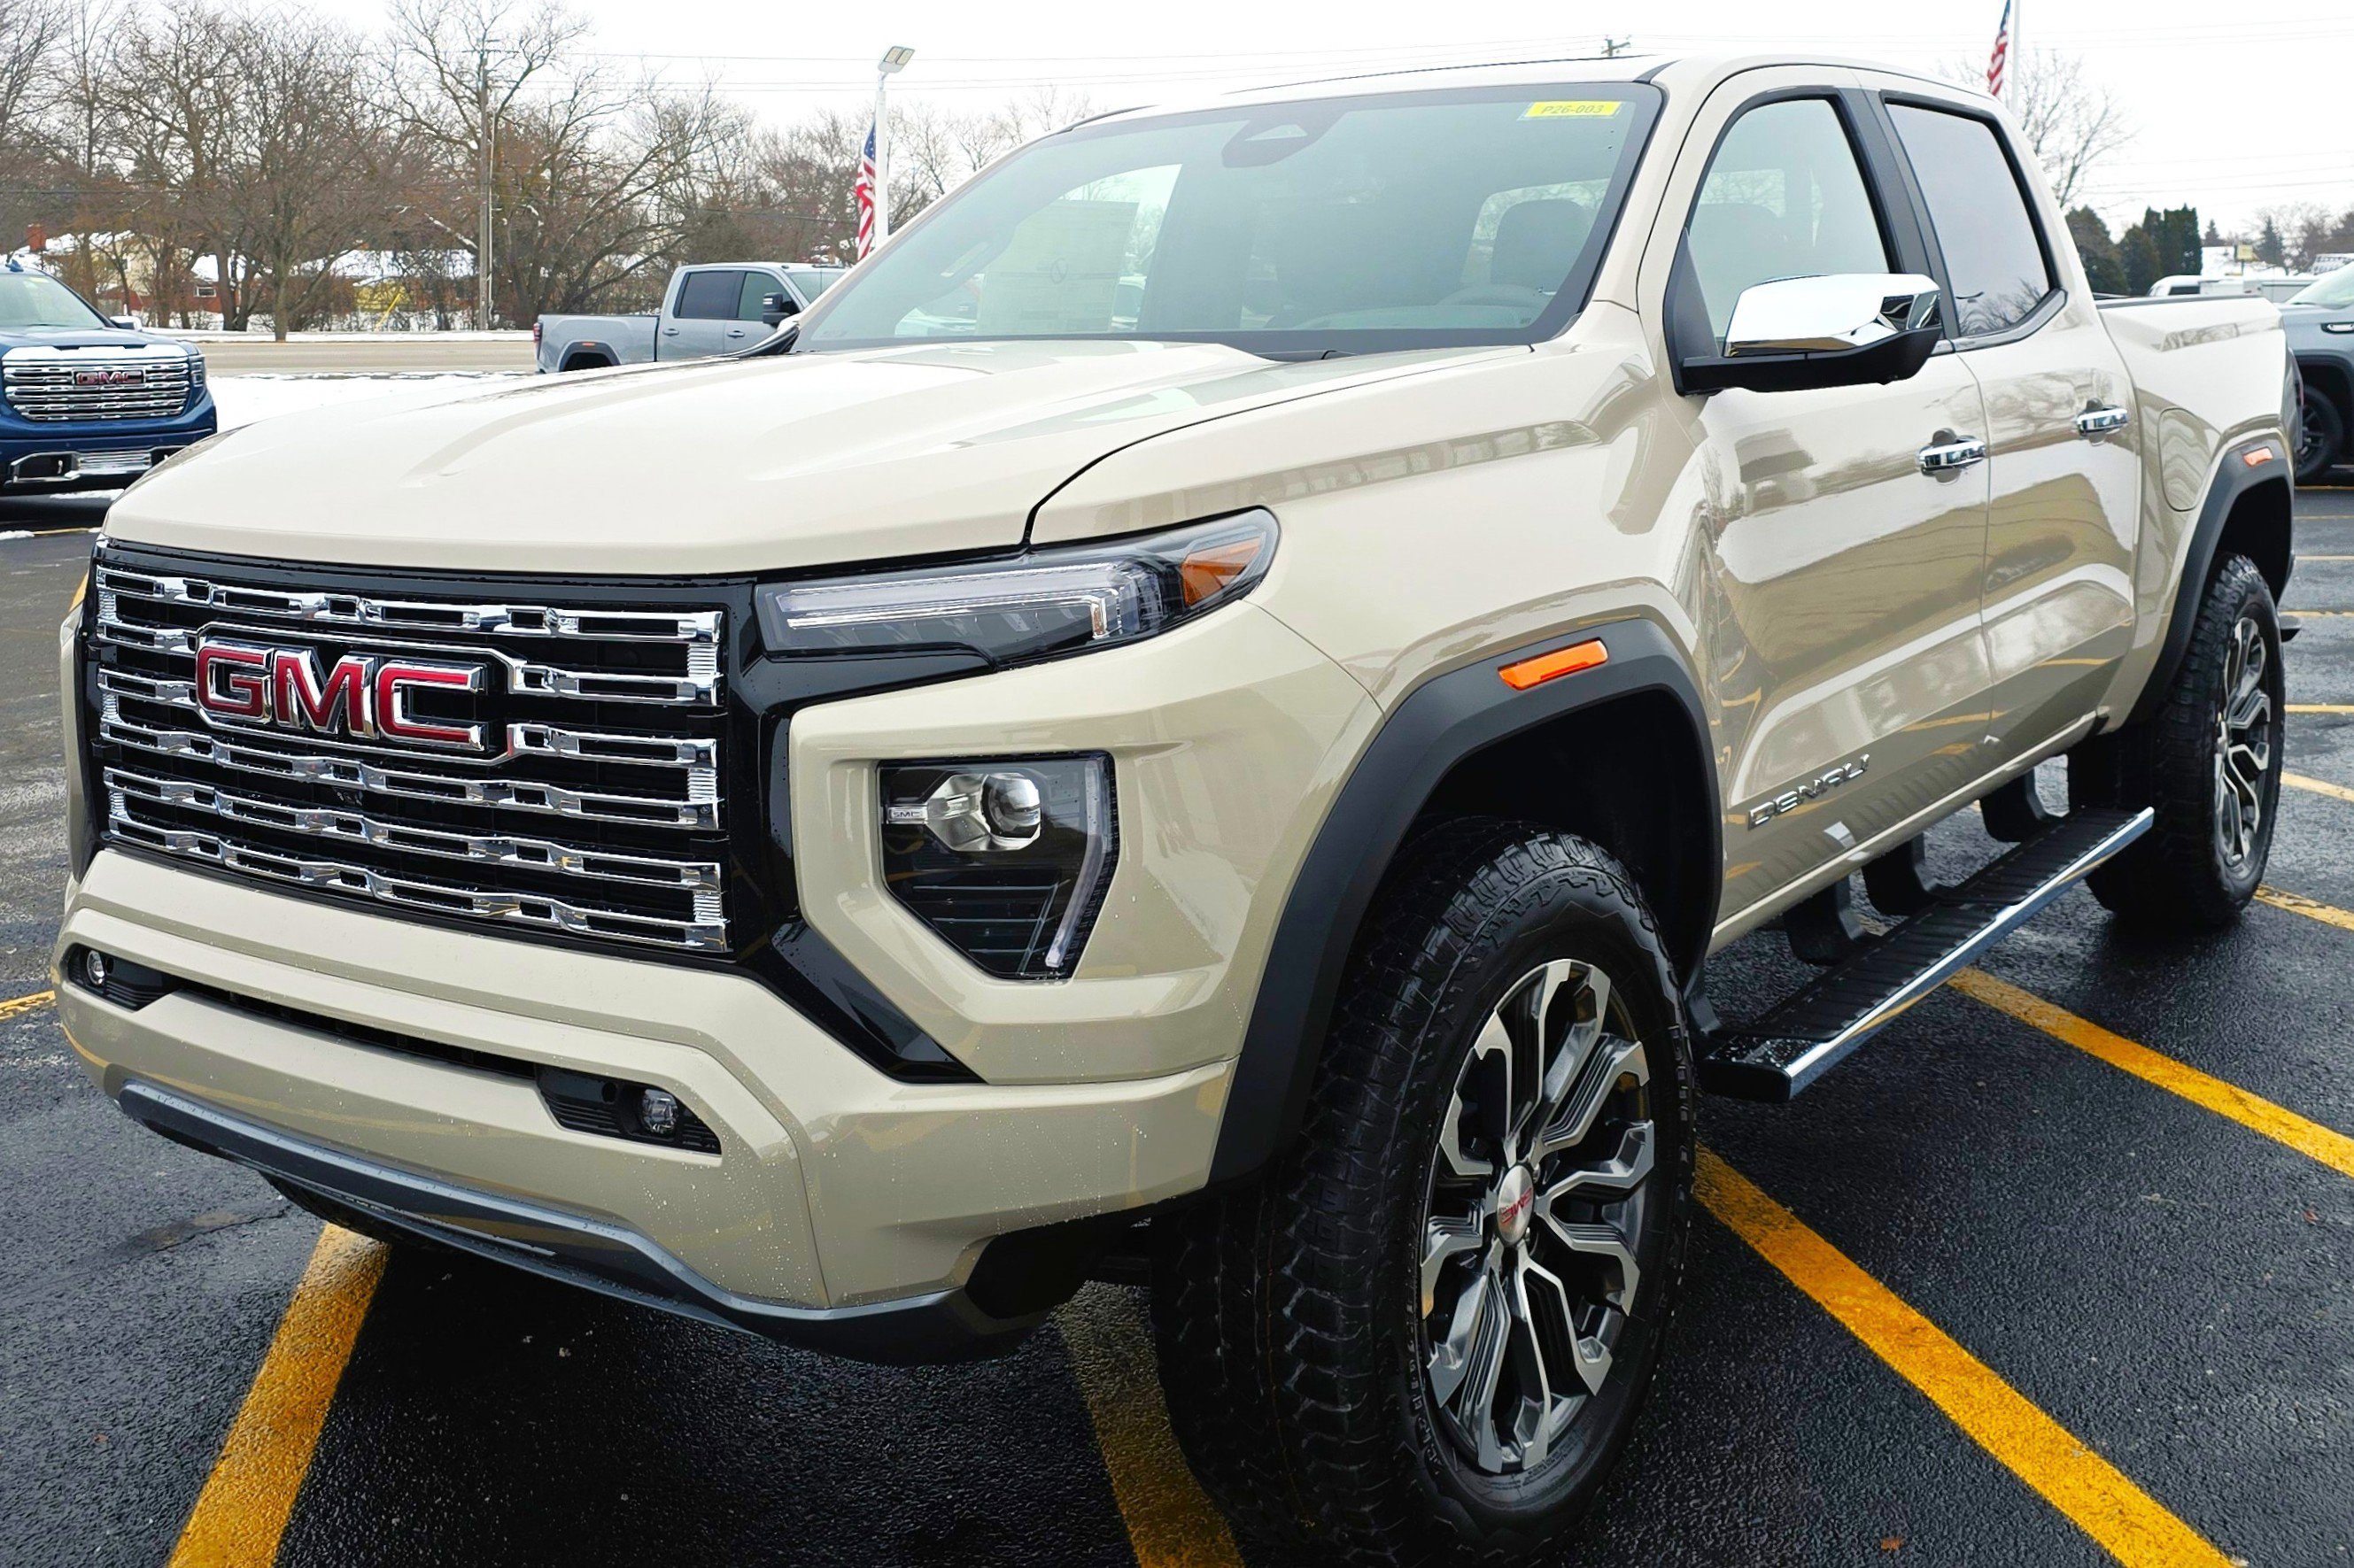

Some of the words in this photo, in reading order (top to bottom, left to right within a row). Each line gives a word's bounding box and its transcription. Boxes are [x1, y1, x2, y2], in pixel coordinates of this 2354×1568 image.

[1541, 104, 1605, 114] P26-003
[75, 370, 143, 385] GMC
[195, 639, 492, 752] GMC
